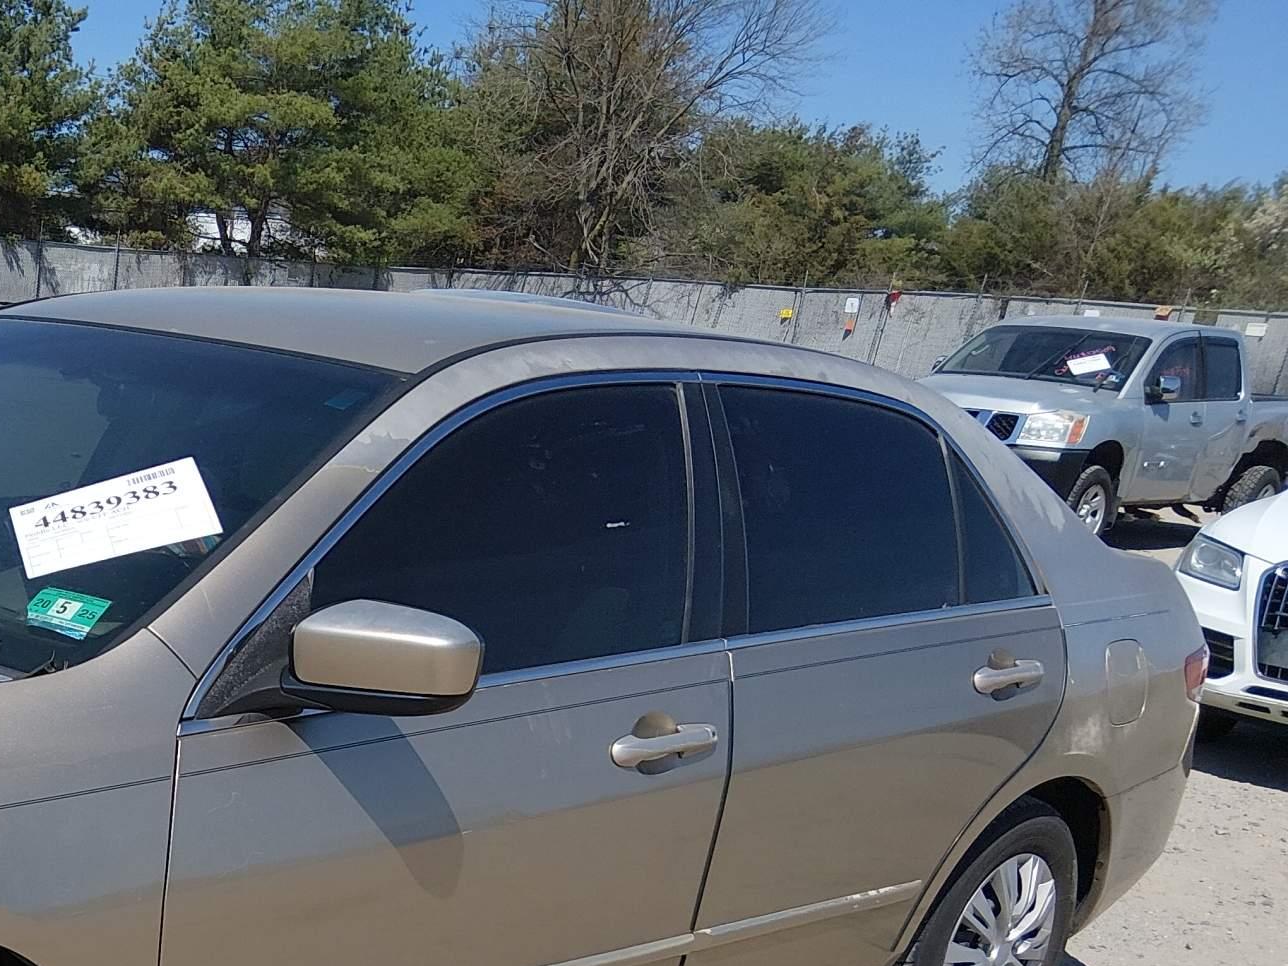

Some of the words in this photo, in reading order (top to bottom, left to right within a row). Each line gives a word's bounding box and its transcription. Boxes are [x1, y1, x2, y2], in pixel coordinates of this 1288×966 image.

[34, 480, 178, 529] 44839383
[33, 598, 52, 609] 20
[55, 601, 72, 615] 5
[79, 608, 98, 620] 25
